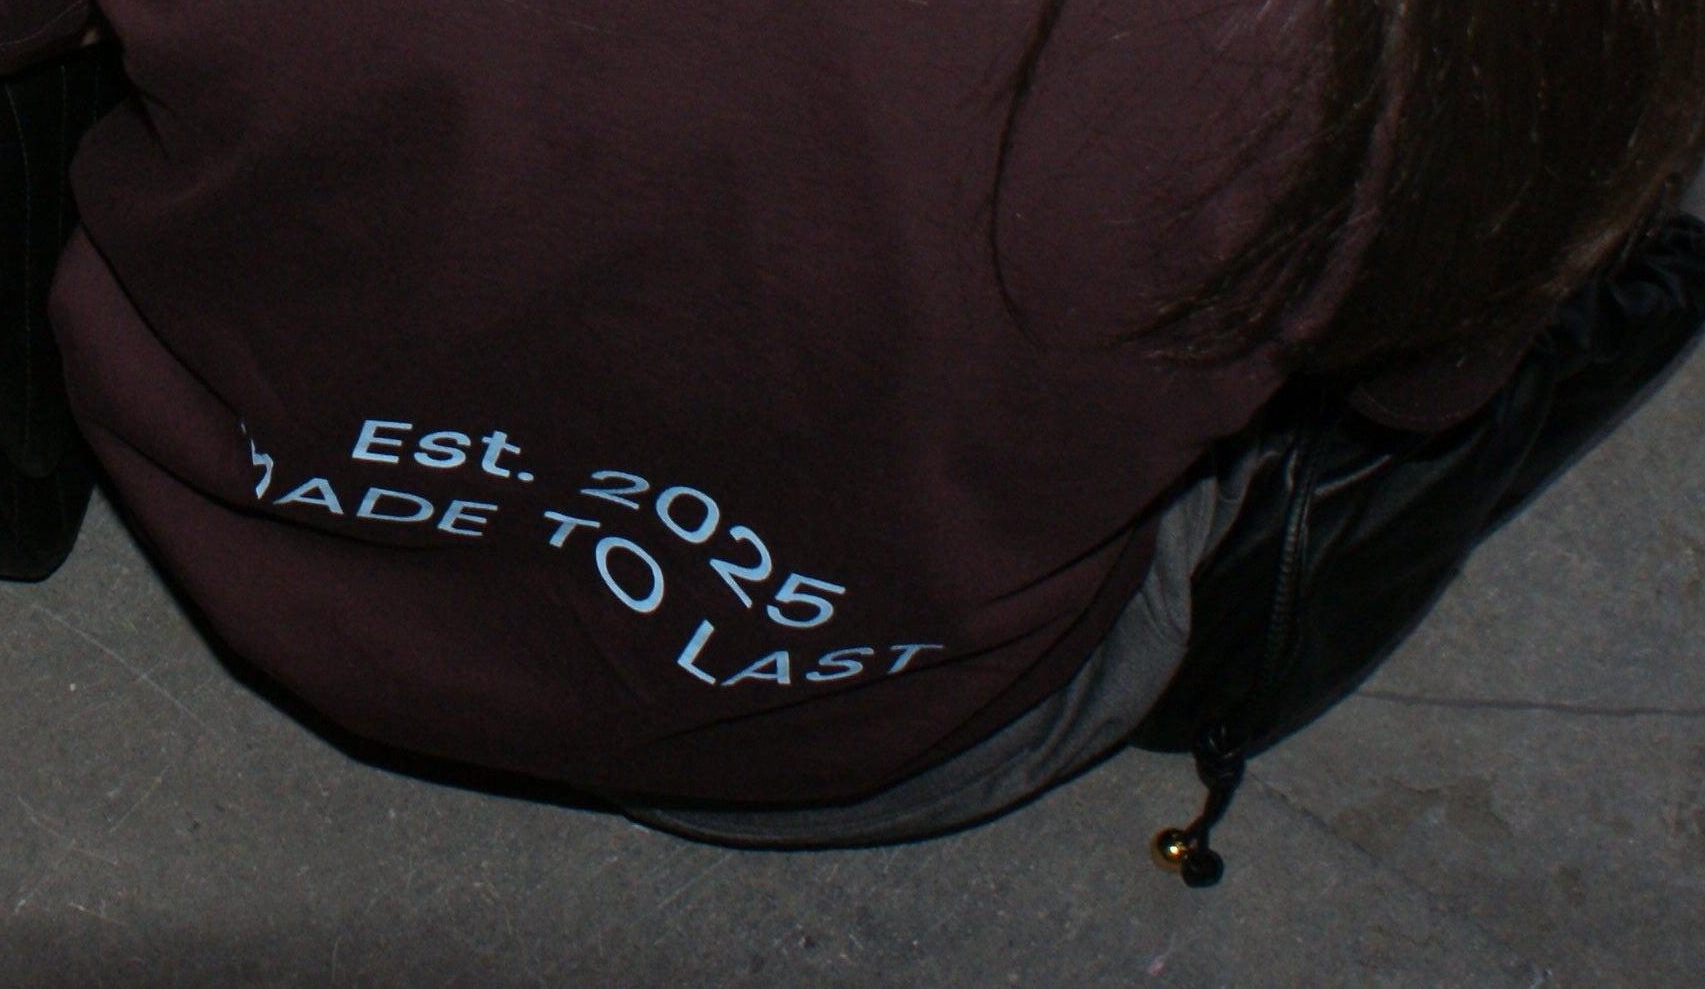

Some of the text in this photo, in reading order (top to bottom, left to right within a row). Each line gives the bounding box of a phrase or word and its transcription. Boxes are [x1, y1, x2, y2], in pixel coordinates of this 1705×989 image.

[351, 419, 847, 629] Est. 2025
[543, 510, 665, 614] TO
[676, 619, 945, 688] LAST
